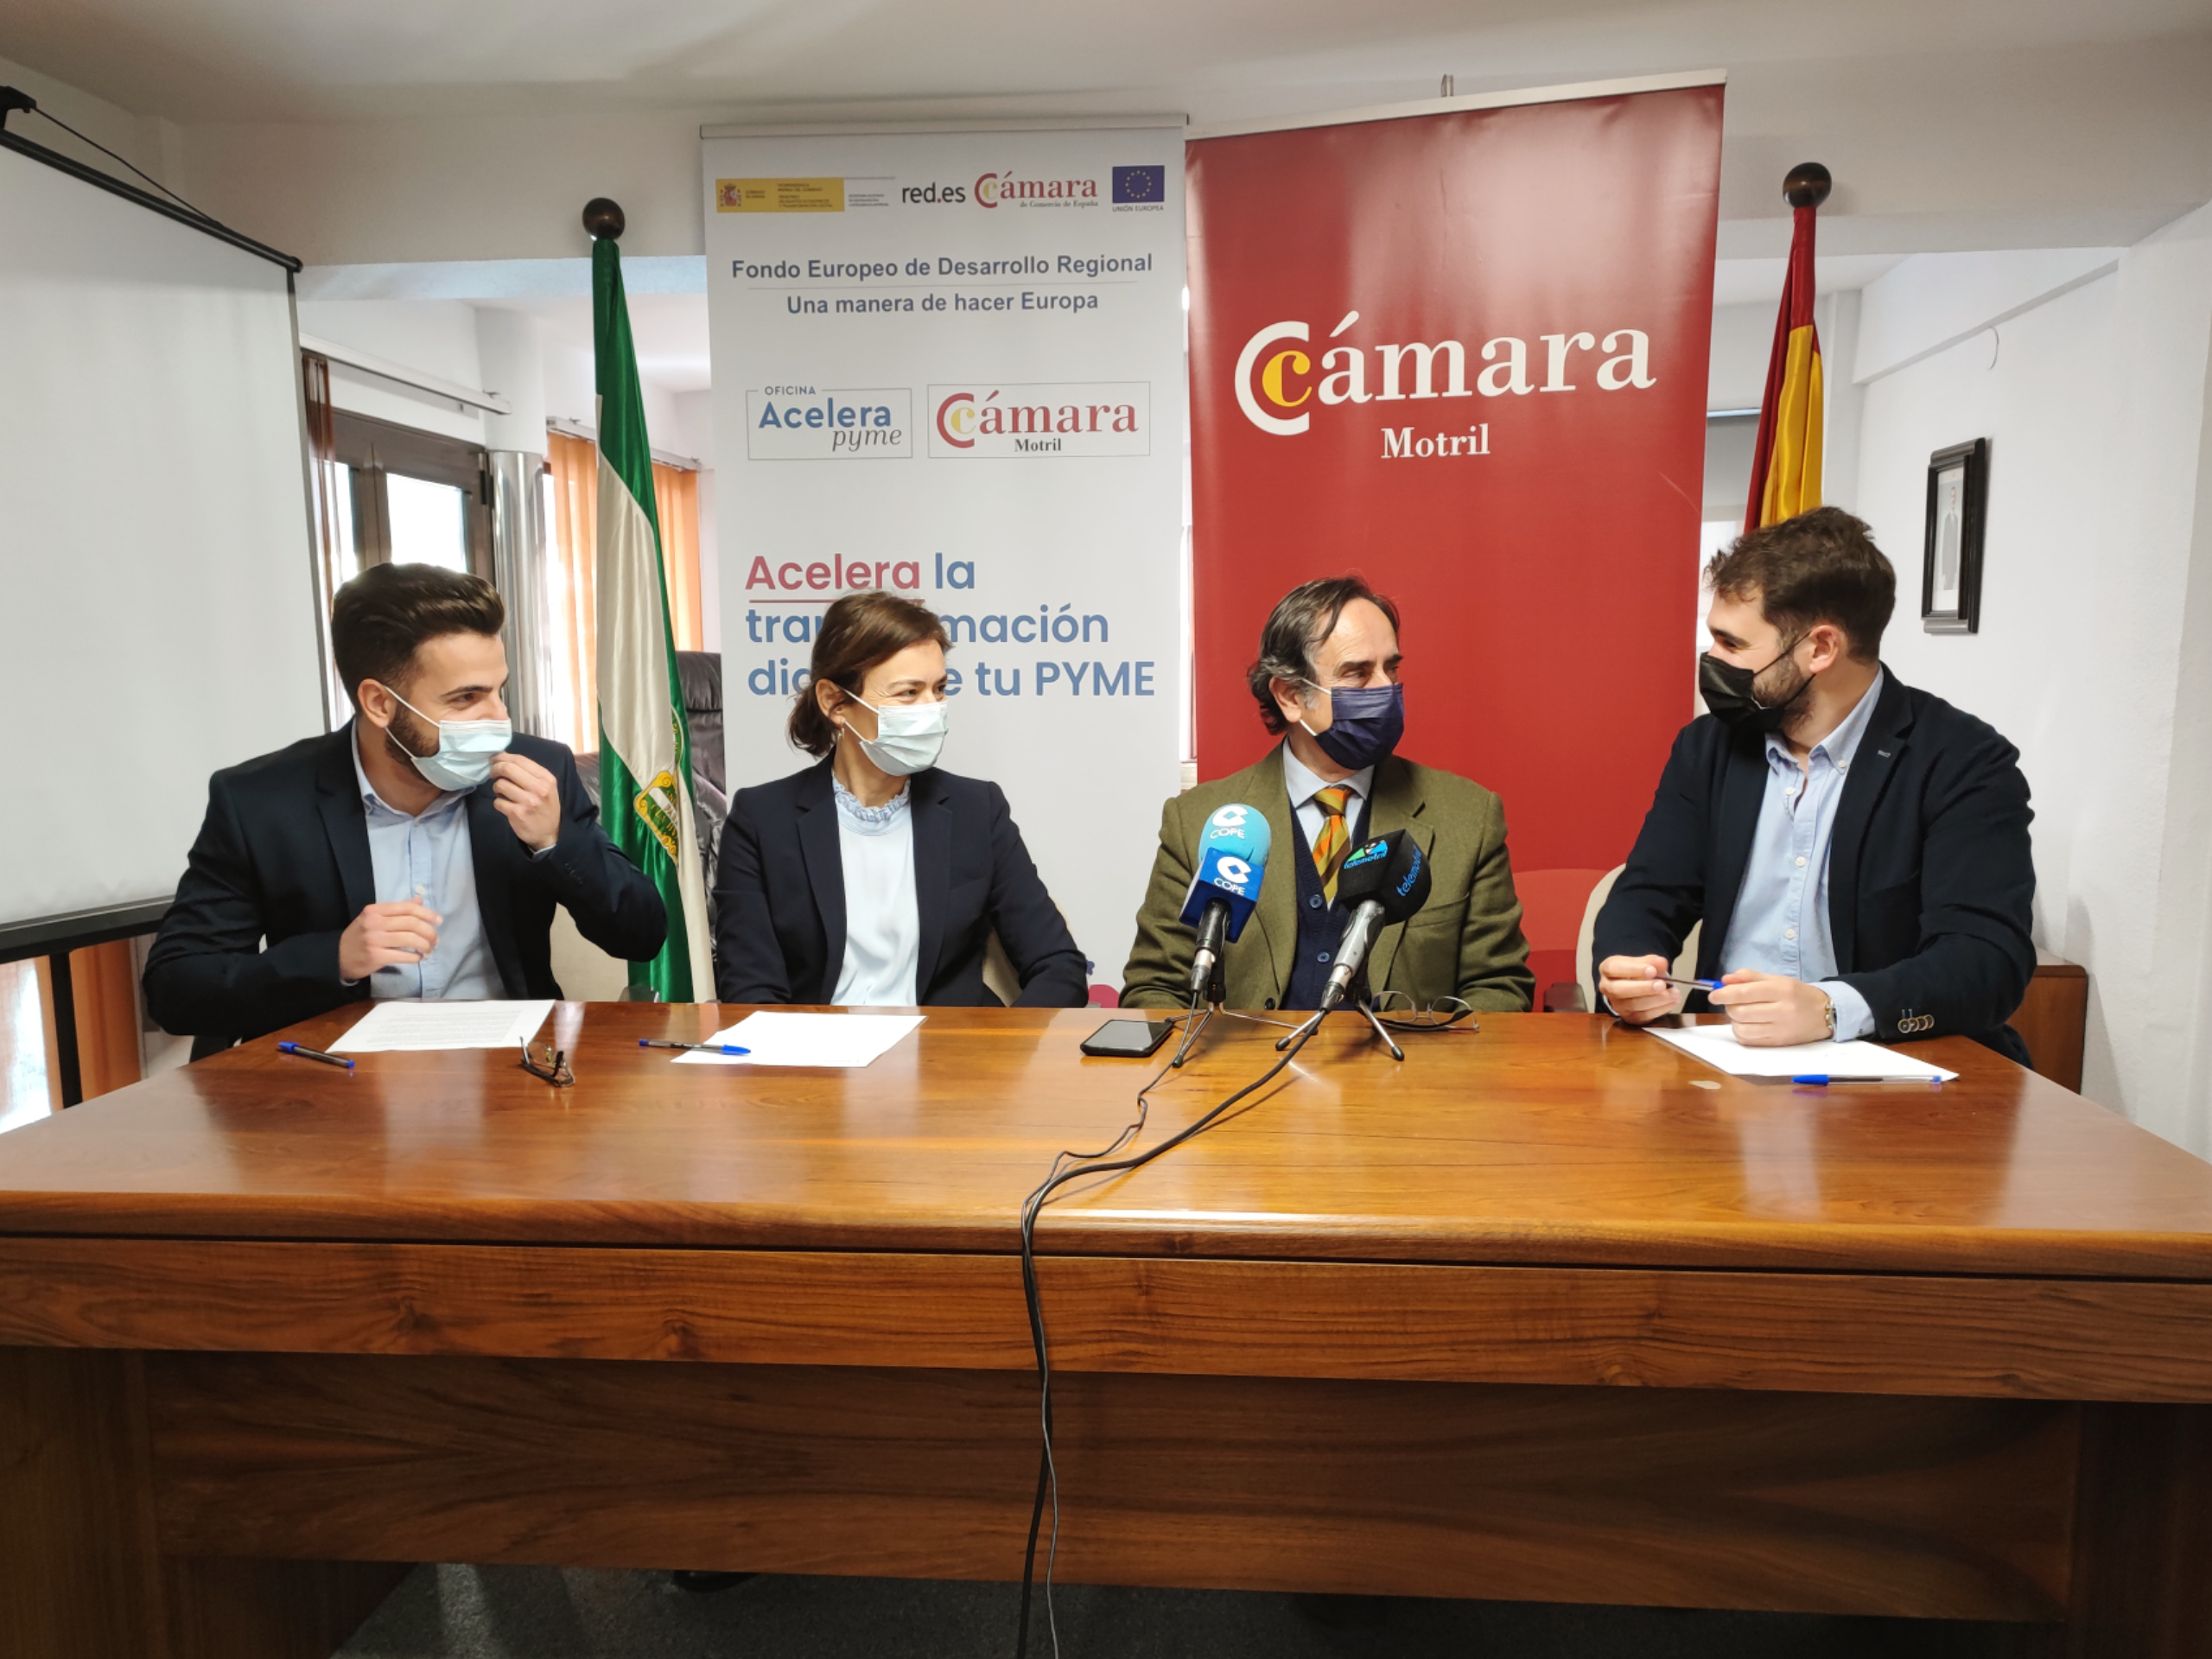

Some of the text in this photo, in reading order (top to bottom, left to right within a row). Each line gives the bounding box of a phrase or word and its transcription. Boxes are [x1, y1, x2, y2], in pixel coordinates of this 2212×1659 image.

[902, 181, 966, 204] red.es
[732, 252, 1152, 282] Fondo Europeo de Desarrollo Regional
[787, 291, 1098, 315] Una manera de hacer Europa
[764, 385, 817, 396] OFICINA
[758, 397, 892, 429] Acelera
[831, 428, 902, 452] pyme
[1014, 437, 1062, 452] Motril
[1382, 423, 1491, 459] Motril
[745, 552, 976, 591] Acelera la
[974, 661, 1020, 696] tu
[1036, 661, 1155, 696] PYME
[1210, 827, 1245, 839] COPE
[1213, 876, 1246, 897] COPE
